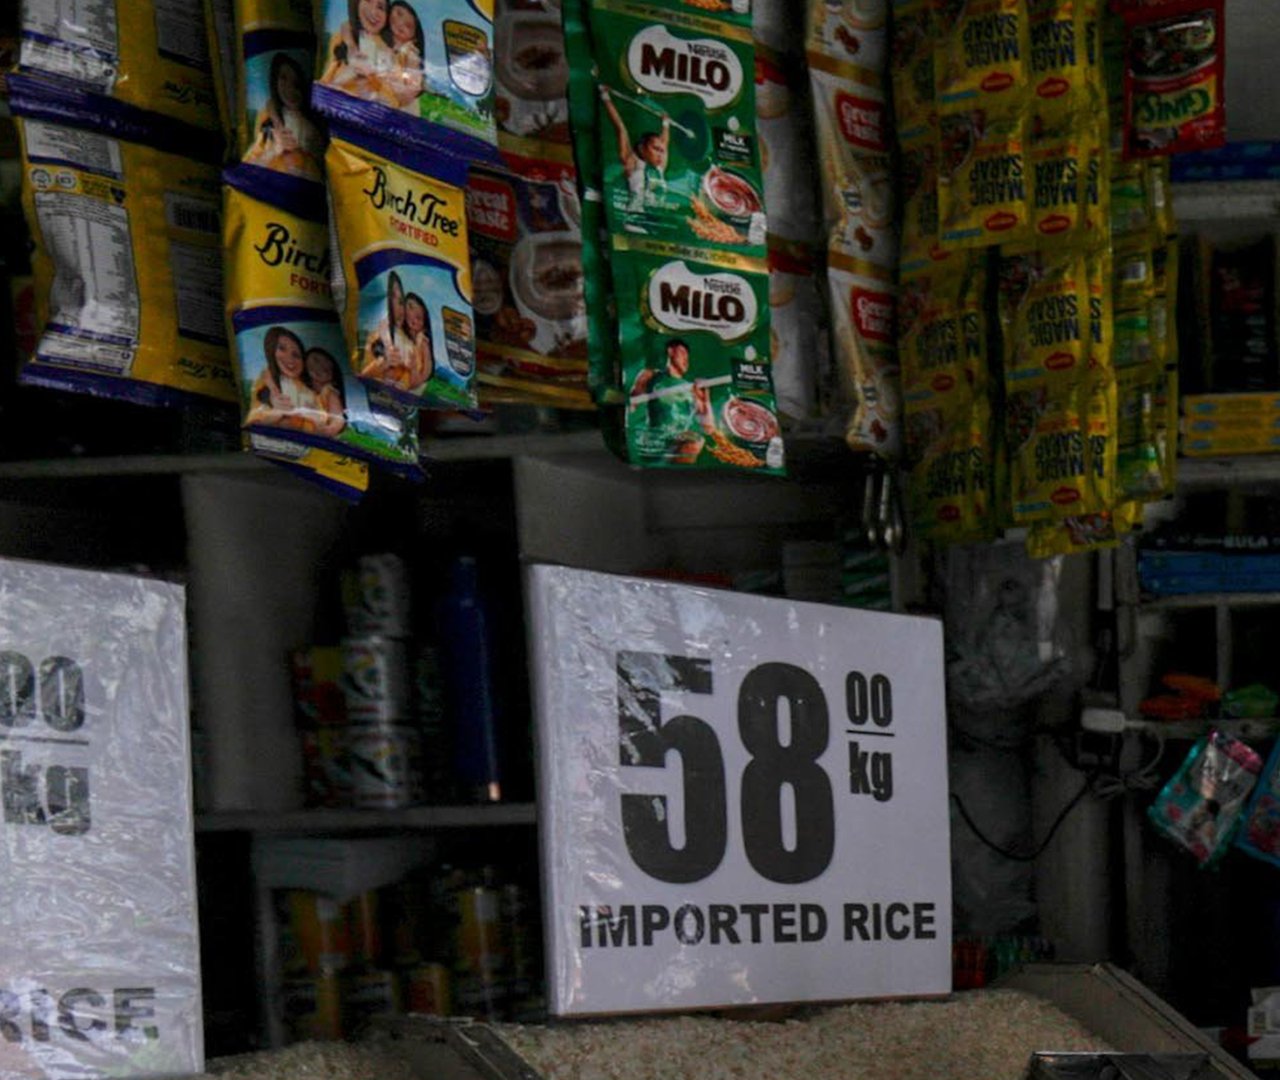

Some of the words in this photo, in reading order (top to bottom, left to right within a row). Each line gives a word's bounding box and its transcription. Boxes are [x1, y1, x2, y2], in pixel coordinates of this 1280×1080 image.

[641, 43, 730, 91] MILO
[1031, 46, 1076, 72] MAGI
[1035, 158, 1077, 183] SARA
[363, 166, 416, 221] Birch
[418, 193, 459, 237] Tree
[1035, 183, 1077, 208] MAGI
[390, 216, 438, 247] FORTIFIED
[660, 282, 744, 322] MILO
[845, 670, 893, 728] 00
[616, 650, 836, 885] 58
[848, 741, 894, 802] kg
[580, 902, 828, 949] IMPORTED
[843, 901, 937, 942] RICE
